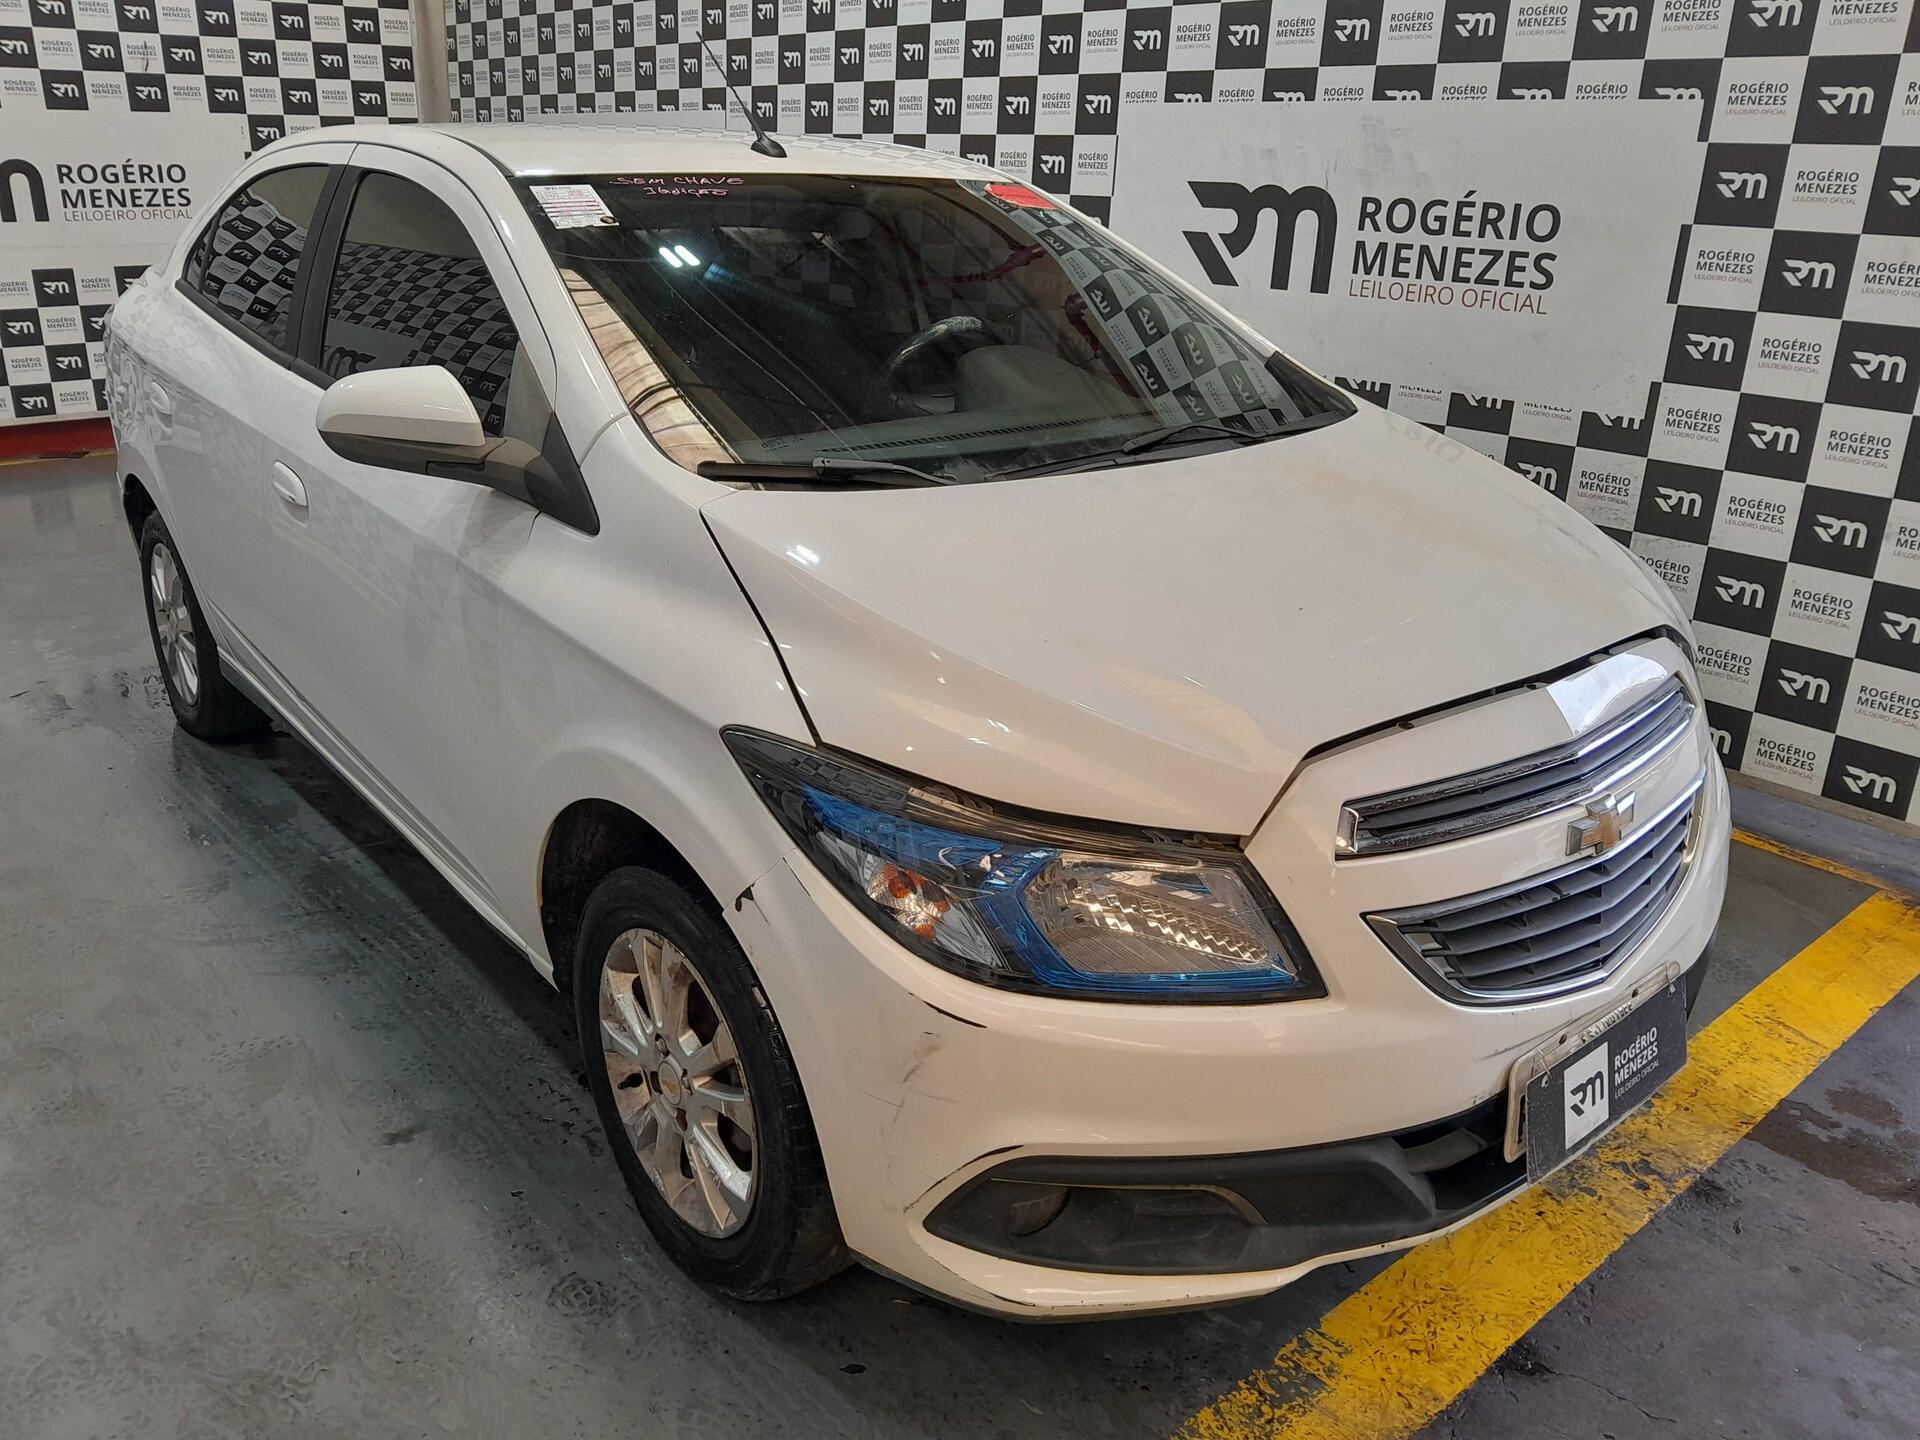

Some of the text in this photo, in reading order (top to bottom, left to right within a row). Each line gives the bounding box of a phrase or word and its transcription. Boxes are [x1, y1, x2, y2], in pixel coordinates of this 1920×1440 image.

[1519, 4, 1568, 16] ROGÉRIO
[1663, 0, 1721, 11] ROGÉRIO
[1832, 2, 1897, 14] MENEZES
[1278, 17, 1315, 28] ROGÉRIO
[1391, 10, 1434, 22] ROGÉRIO
[1517, 16, 1566, 27] MENEZES
[1662, 10, 1720, 22] MENEZES
[1088, 28, 1118, 38] ROGÉRIO
[1177, 23, 1211, 33] ROGÉRIO
[1276, 28, 1314, 38] MENEZES
[1389, 22, 1432, 33] MENEZES
[1125, 89, 1158, 100] ROGÉRIO
[1219, 88, 1255, 100] ROGÉRIO
[1323, 85, 1364, 99] ROGÉRIO
[1442, 83, 1488, 98] ROGÉRIO
[1576, 82, 1629, 98] ROGÉRIO
[1730, 81, 1788, 93] ROGÉRIO
[56, 159, 186, 184] ROGÉRIO
[1797, 169, 1859, 183] ROGÉRIO
[1795, 182, 1857, 195] MENEZES
[60, 188, 192, 208] MENEZES
[64, 208, 192, 222] LEILOEIRO OFICIAL
[1357, 190, 1561, 243] ROGÉRIO
[1698, 249, 1754, 263] ROGÉRIO
[1352, 241, 1558, 291] MENEZES
[1696, 261, 1753, 274] MENEZES
[1348, 278, 1548, 315] LEILOEIRO OFICIAL
[1763, 337, 1821, 353] ROGÉRIO
[1760, 349, 1820, 365] MENEZES
[1668, 407, 1722, 423] ROGÉRIO
[1666, 417, 1720, 434] MENEZES
[1830, 429, 1891, 448] ROGÉRIO
[1827, 441, 1889, 460] MENEZES
[1581, 470, 1630, 487] ROGÉRIO
[1579, 480, 1629, 497] MENEZES
[1730, 495, 1786, 515] ROGÉRIO
[1727, 506, 1784, 525] MENEZES
[1794, 588, 1853, 610] ROGÉRIO
[1791, 599, 1851, 621] MENEZES
[1698, 645, 1752, 665] ROGÉRIO
[1696, 657, 1750, 676] MENEZES
[1860, 686, 1920, 708] ROGÉRIO
[1857, 696, 1920, 720] MENEZES
[1759, 737, 1815, 762] ROGÉRIO
[1757, 747, 1814, 772] MENEZES
[1615, 1027, 1657, 1070] ROGÉRIO
[1615, 1042, 1658, 1086] MENEZES
[1616, 1061, 1659, 1099] LEILOEIRO OFICIAL
